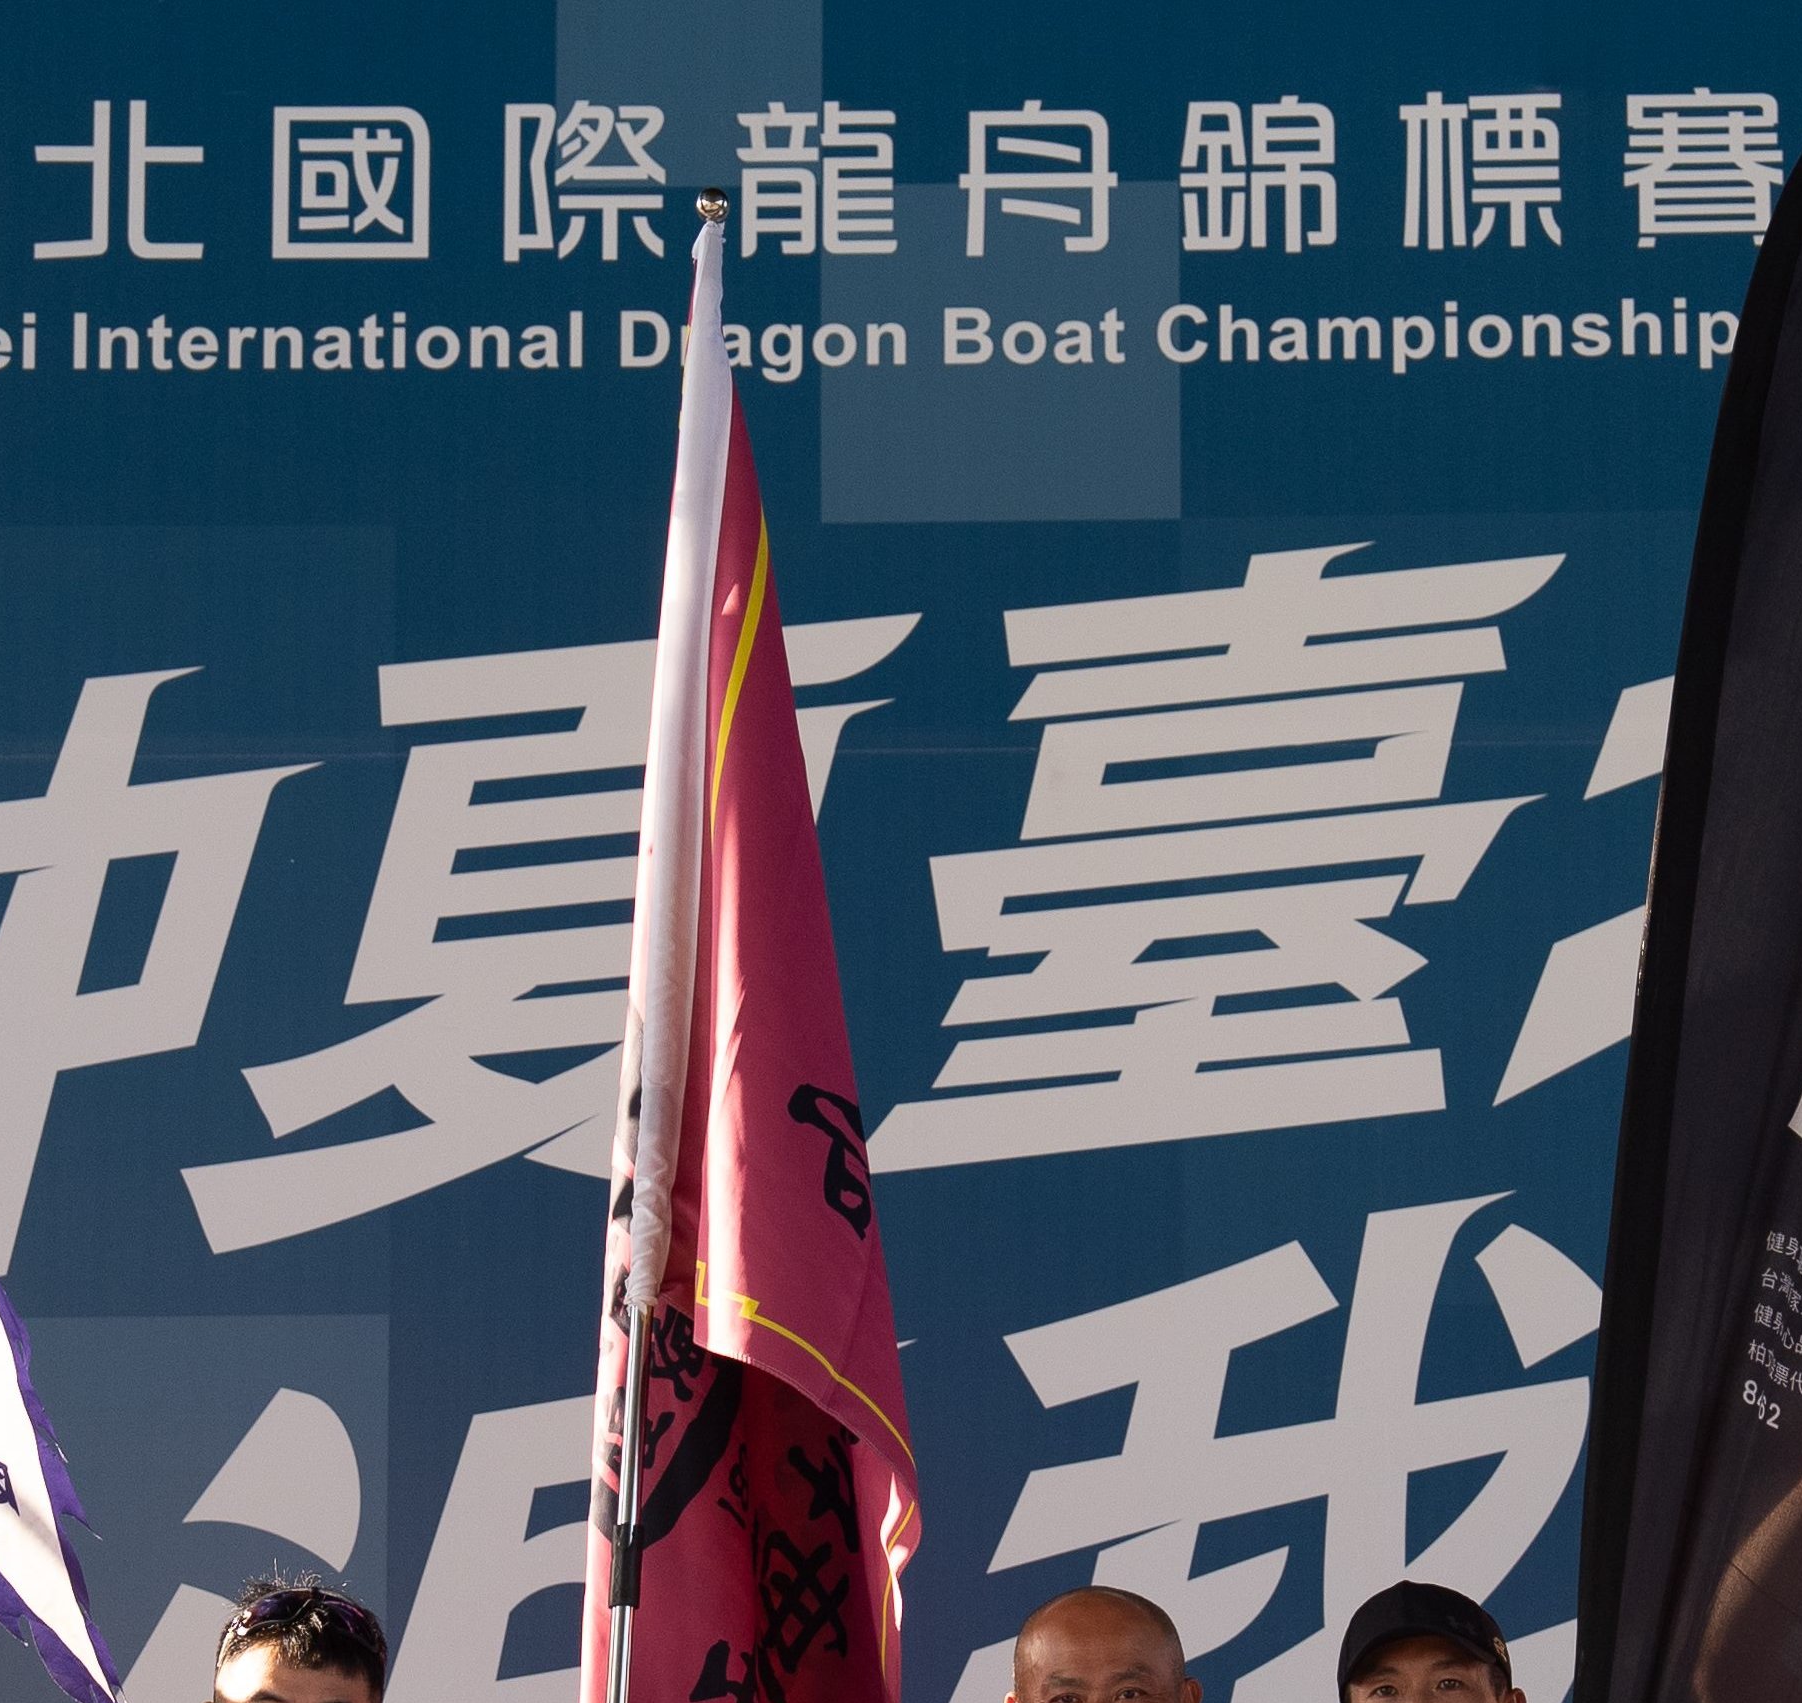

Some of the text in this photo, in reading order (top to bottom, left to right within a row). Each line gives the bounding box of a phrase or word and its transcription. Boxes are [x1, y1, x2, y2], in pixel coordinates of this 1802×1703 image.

[73, 310, 583, 371] International
[620, 310, 906, 382] Dagon
[943, 307, 1125, 366] Boat
